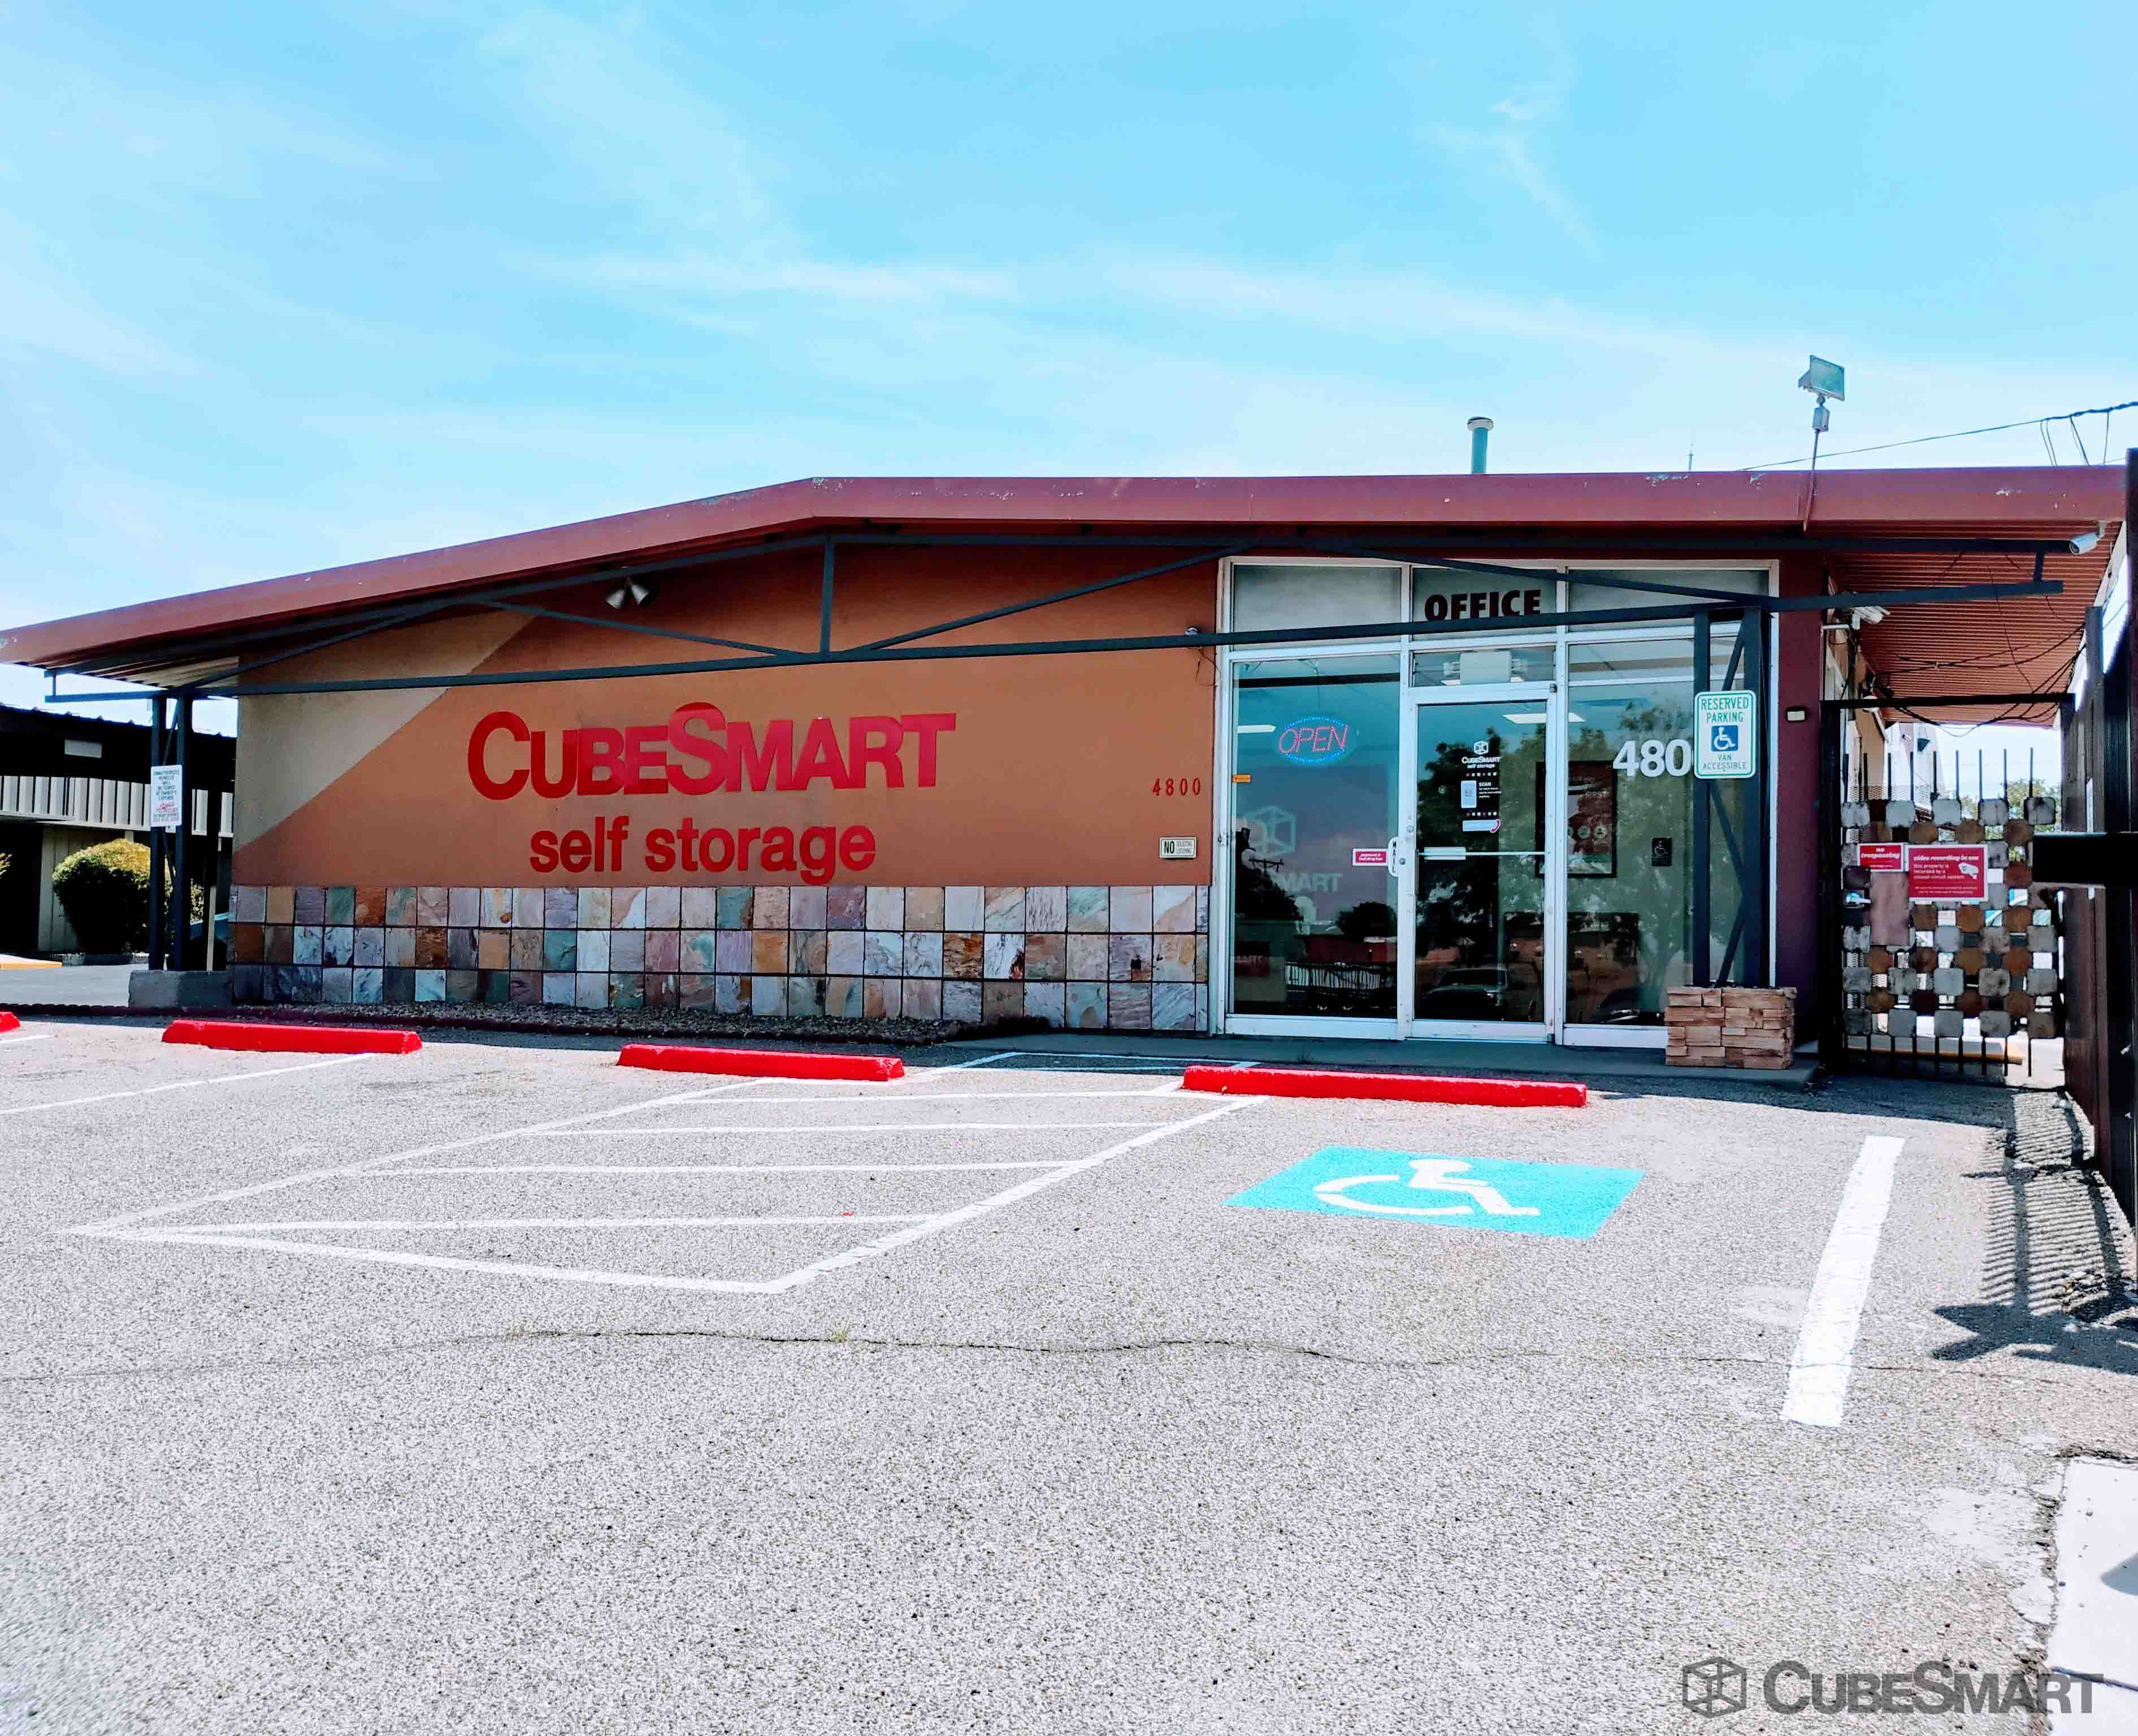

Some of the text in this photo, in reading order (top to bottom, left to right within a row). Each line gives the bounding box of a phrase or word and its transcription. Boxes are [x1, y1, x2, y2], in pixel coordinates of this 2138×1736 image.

[1425, 589, 1541, 621] OFFICE
[1701, 697, 1749, 710] RESERVED
[1706, 711, 1744, 723] PARKING
[1279, 724, 1348, 753] OPEN
[1612, 739, 1694, 777] 480
[1702, 761, 1746, 770] ACCESSIBLE
[1152, 778, 1201, 796] 4800
[530, 815, 877, 886] self storage
[1164, 841, 1175, 854] NO
